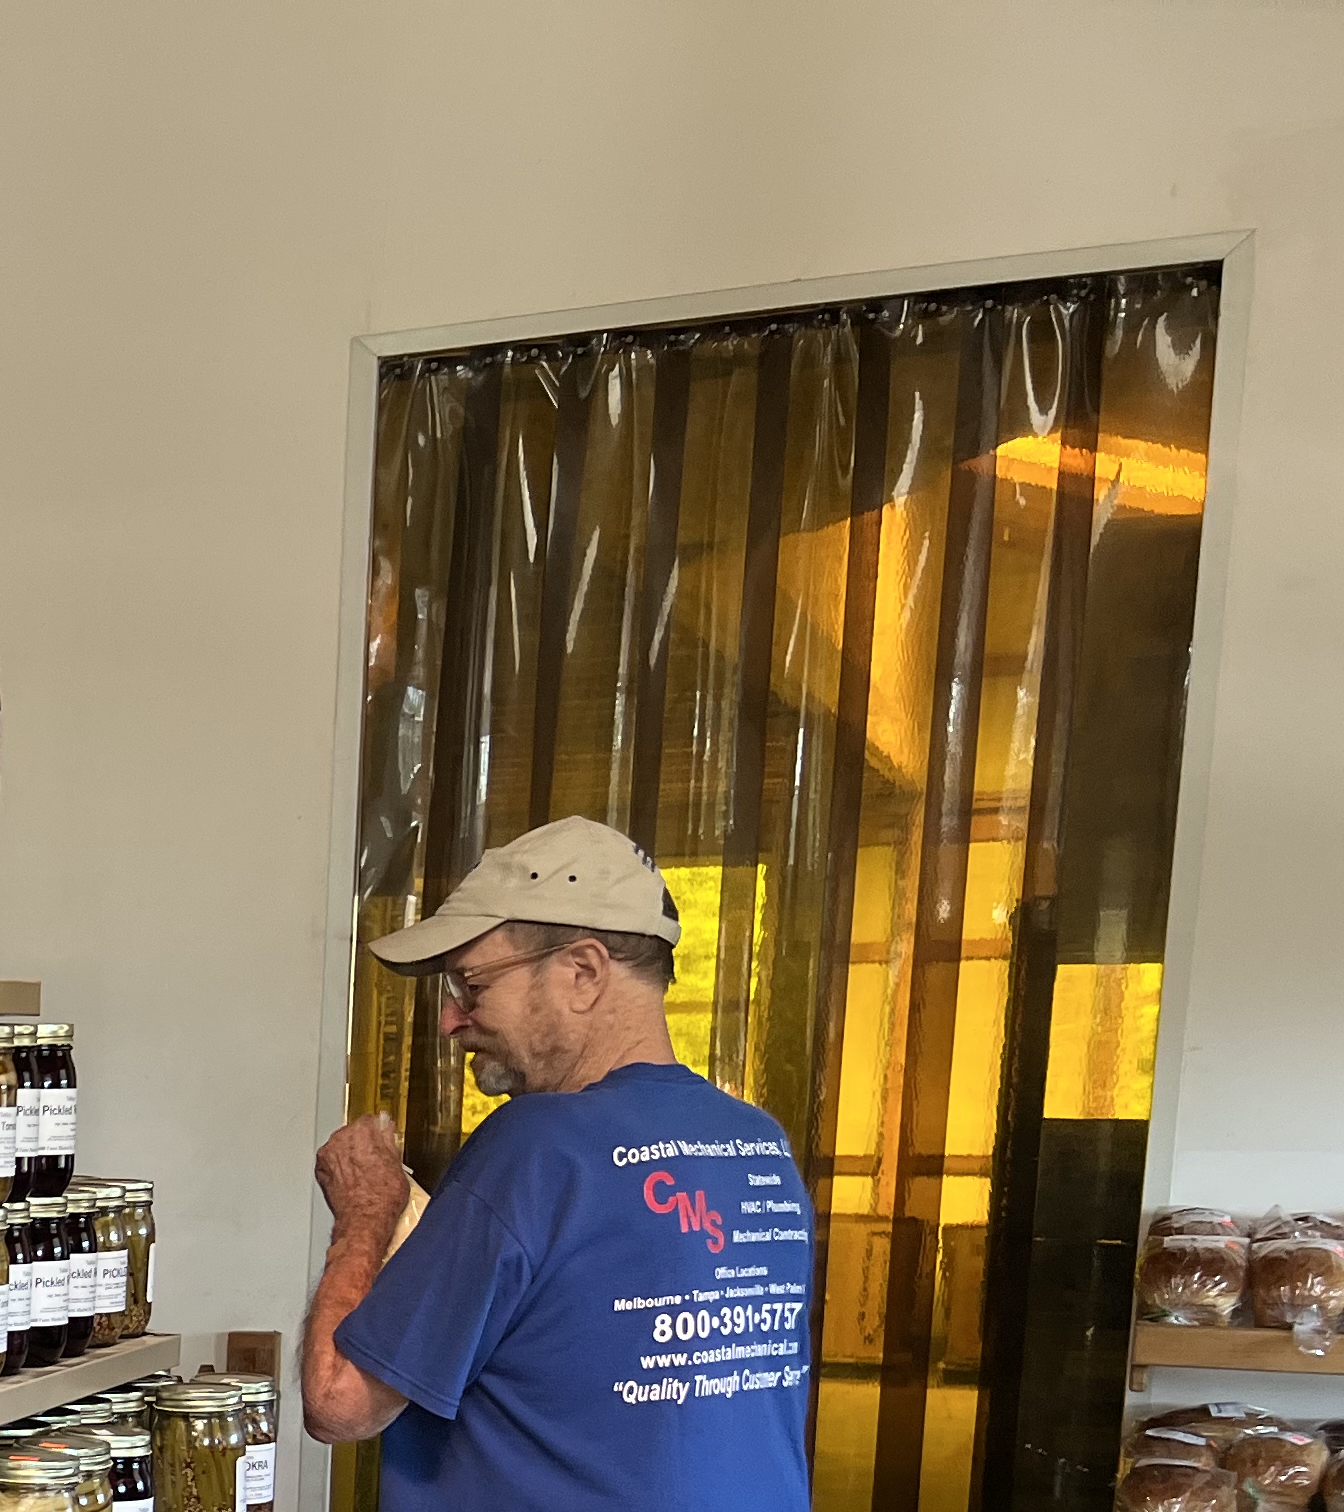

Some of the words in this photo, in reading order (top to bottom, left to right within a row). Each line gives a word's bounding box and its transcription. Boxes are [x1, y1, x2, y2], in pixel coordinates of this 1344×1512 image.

[612, 1140, 678, 1167] Coastal
[679, 1141, 736, 1158] Mechanical
[643, 1170, 725, 1253] CMS
[613, 1293, 682, 1312] Melbourne
[692, 1289, 720, 1303] Tampa
[694, 1370, 740, 1399] Through
